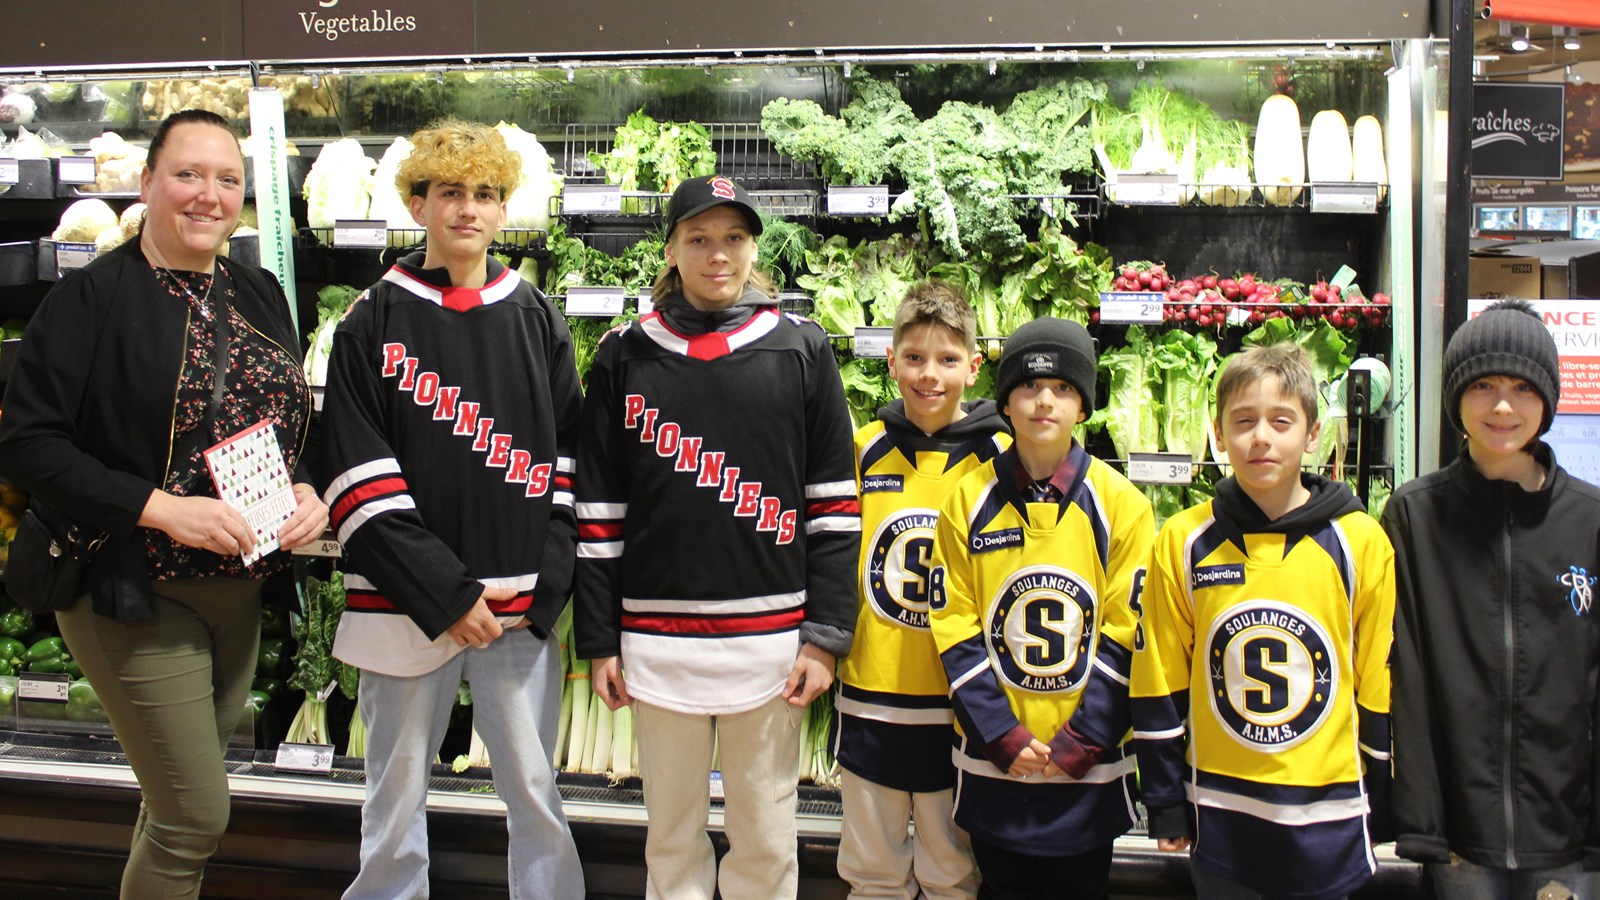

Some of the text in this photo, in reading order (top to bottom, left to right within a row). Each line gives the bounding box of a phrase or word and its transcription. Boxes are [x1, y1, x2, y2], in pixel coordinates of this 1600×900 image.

[298, 9, 417, 41] Vegetables
[1471, 108, 1532, 131] raîches
[867, 195, 886, 208] 399
[1141, 304, 1161, 316] 299
[1562, 361, 1600, 370] libre-se
[1575, 379, 1600, 389] barre
[382, 342, 552, 498] PIONNIERS
[624, 394, 797, 545] PIONNIERS
[1169, 465, 1189, 478] 399
[864, 478, 901, 489] Desjardins
[890, 516, 938, 536] SOULAN
[321, 542, 339, 554] 499
[984, 533, 1021, 546] Desjardins
[1196, 569, 1241, 582] Desjardins
[1011, 575, 1080, 597] SOULANGES
[898, 608, 930, 627] A.H.M
[1225, 611, 1306, 637] SOULANGES
[1022, 597, 1068, 668] S
[1020, 675, 1073, 690] A.H.M.S.
[1241, 634, 1290, 716] S
[1242, 723, 1298, 743] A.H.M.S.
[311, 754, 330, 767] 399
